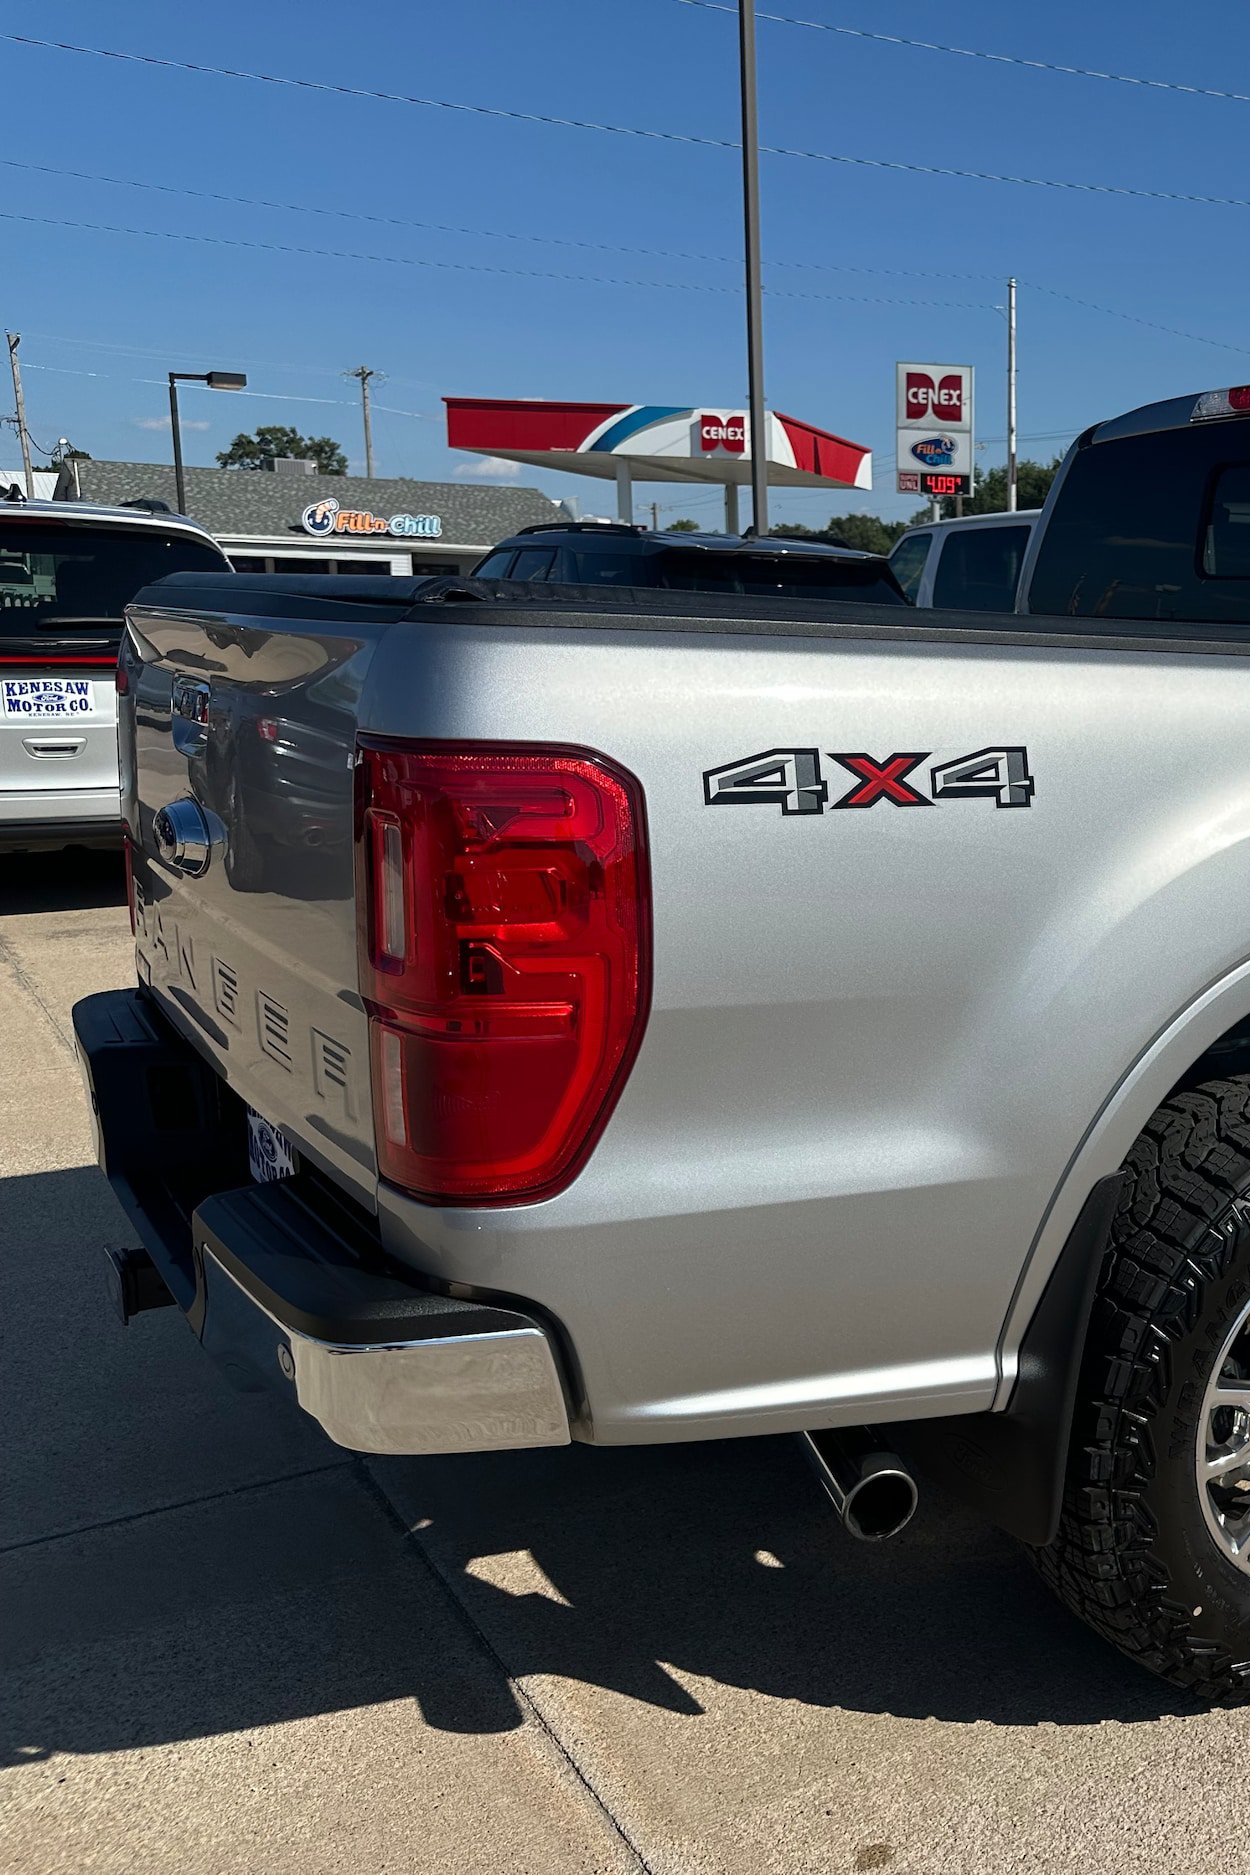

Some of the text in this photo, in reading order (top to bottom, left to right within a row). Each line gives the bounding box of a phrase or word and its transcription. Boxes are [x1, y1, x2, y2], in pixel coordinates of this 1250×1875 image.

[907, 387, 961, 406] CENEX
[702, 426, 744, 440] CENEX
[900, 481, 918, 490] UNL
[5, 682, 89, 696] KENESAW
[7, 698, 93, 712] MOTOR CO.
[133, 875, 358, 1123] RANGER
